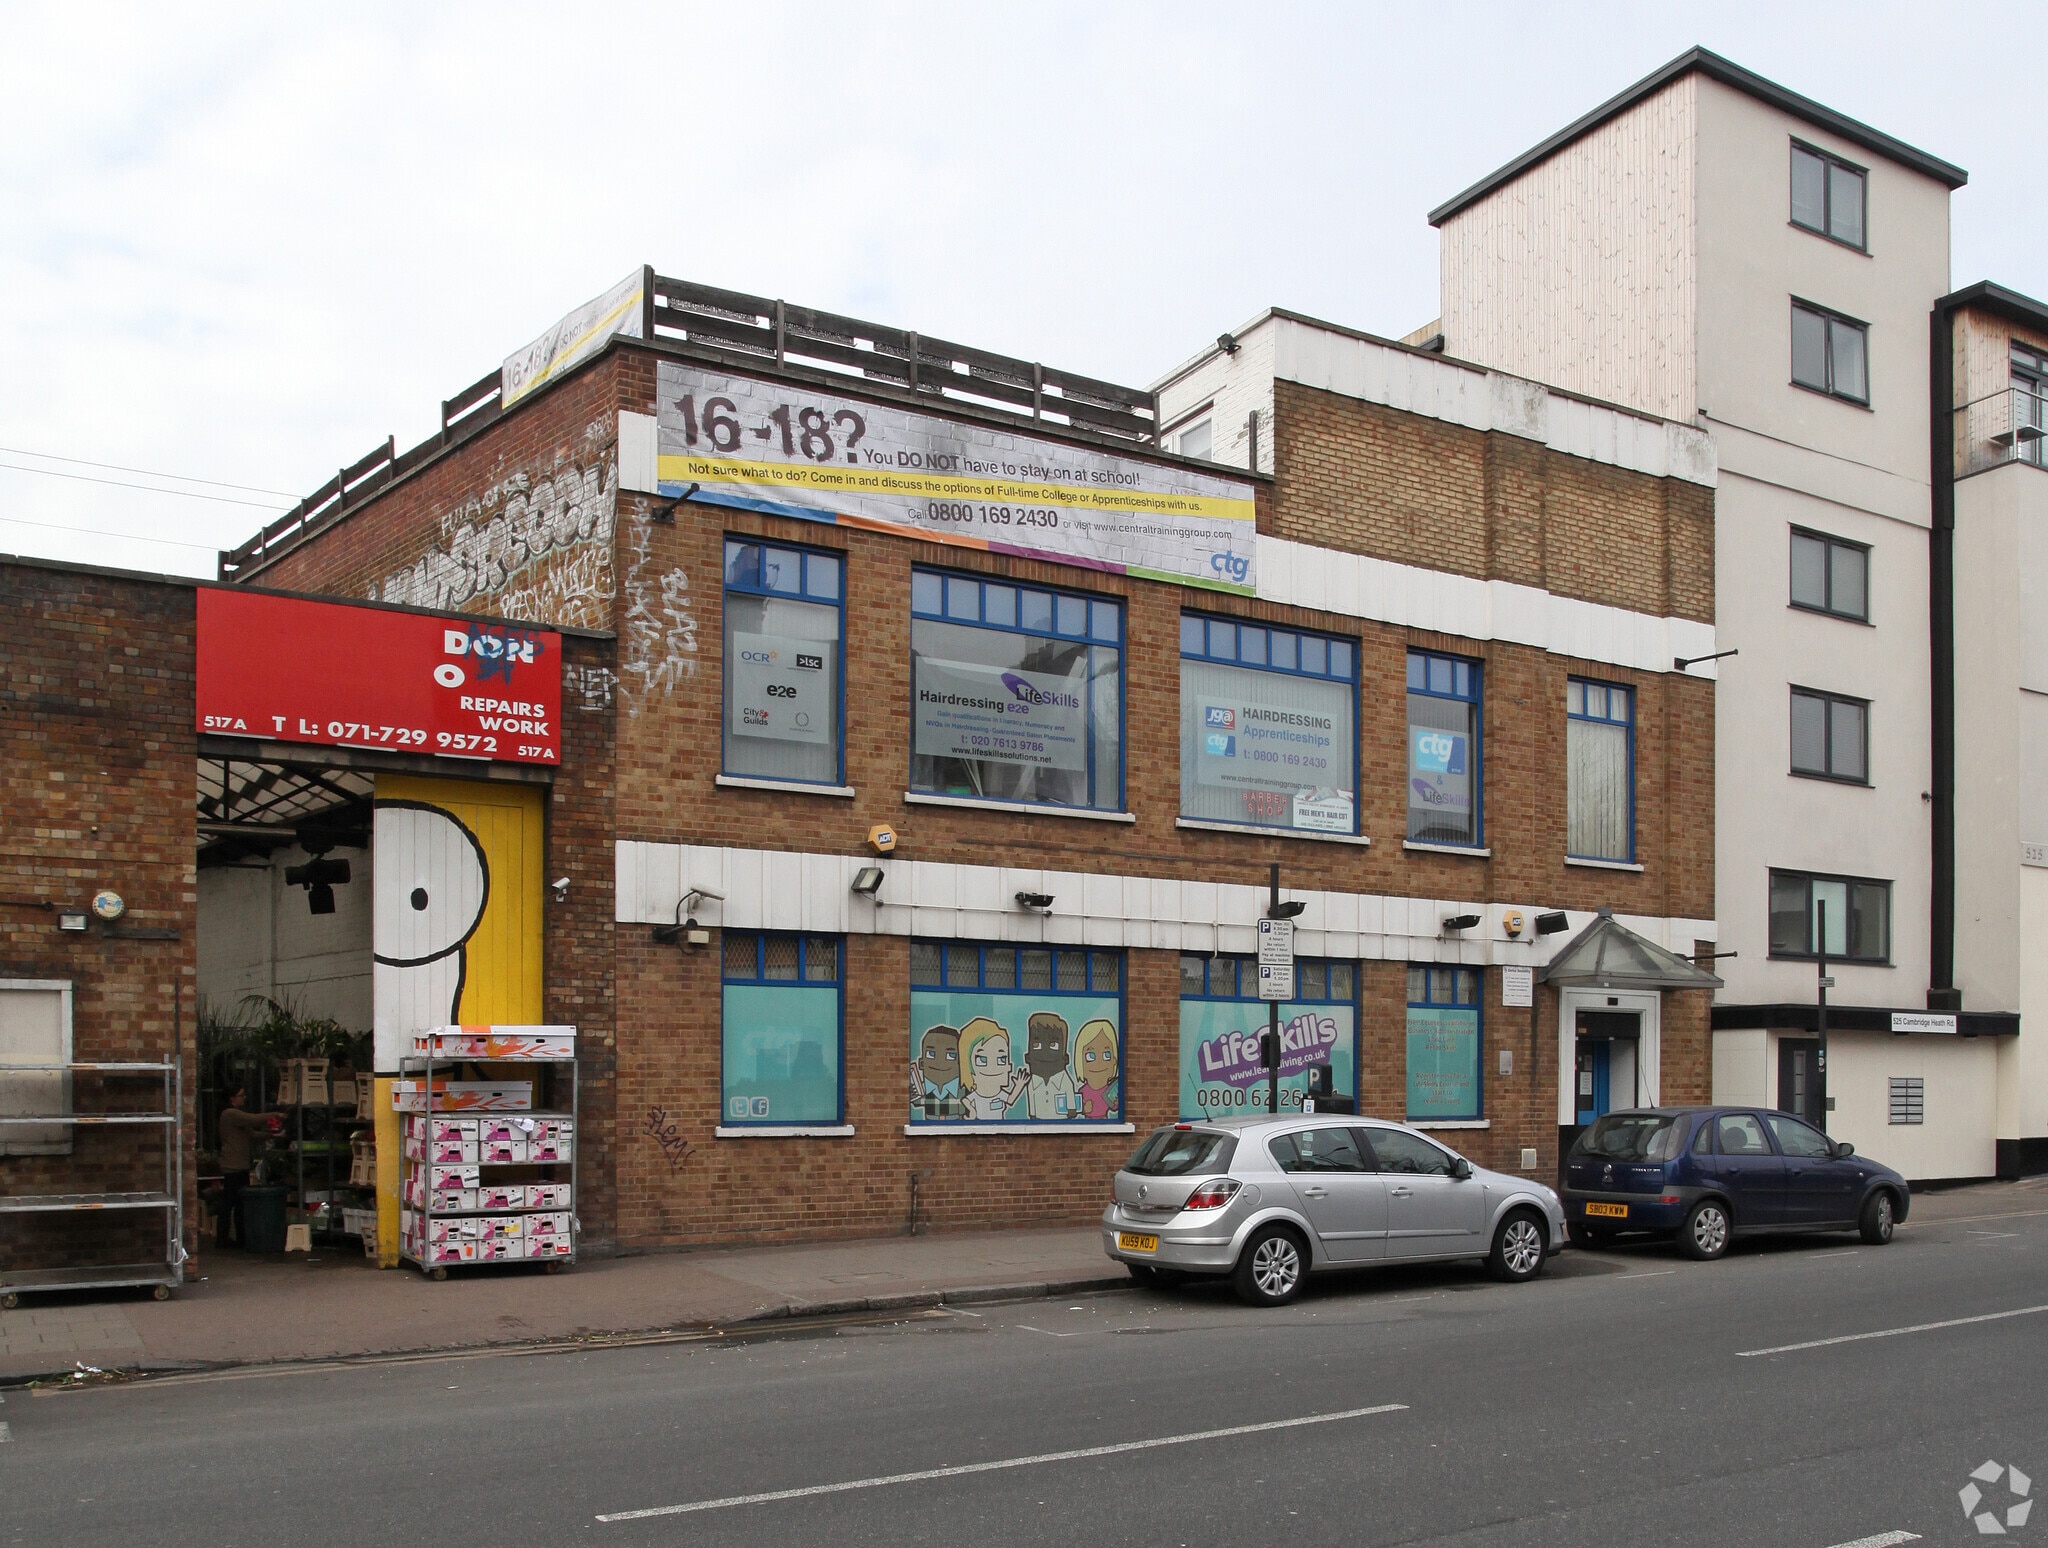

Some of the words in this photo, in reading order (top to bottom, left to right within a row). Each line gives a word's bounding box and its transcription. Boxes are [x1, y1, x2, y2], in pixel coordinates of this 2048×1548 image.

[864, 449, 893, 466] You
[898, 451, 922, 468] DO
[926, 452, 959, 470] NOT
[963, 457, 998, 474] have
[1001, 461, 1016, 475] to
[1020, 464, 1050, 481] stay
[1053, 469, 1071, 480] on
[1075, 468, 1087, 482] at
[1091, 470, 1140, 486] school!
[688, 462, 710, 475] Not
[712, 465, 738, 477] sure
[741, 467, 769, 479] what
[771, 469, 783, 480] to
[786, 468, 807, 482] do?
[810, 471, 843, 485] Come
[846, 473, 856, 485] in
[858, 476, 879, 487] and
[881, 478, 922, 490] discuss
[925, 480, 941, 491] the
[943, 483, 982, 495] options
[984, 484, 995, 495] of
[997, 485, 1039, 498] Full-time
[1042, 489, 1078, 503] College
[1092, 493, 1166, 510] Apprenticeships
[1167, 500, 1187, 510] with
[1189, 503, 1203, 511] us.
[908, 508, 927, 520] Call
[928, 502, 973, 522] 0800
[979, 505, 1011, 525] 169
[1015, 508, 1058, 528] 2430
[1063, 521, 1072, 529] or
[1074, 521, 1092, 531] visit
[1093, 522, 1233, 539] www.centraltraininggroup.com
[1210, 549, 1250, 582] ctg
[741, 651, 770, 663] OCR
[433, 664, 466, 688] O
[767, 684, 797, 698] e2e
[1016, 686, 1079, 709] LifeSkills
[460, 695, 546, 718] REPAIRS
[920, 690, 1004, 713] Hairdressing
[1007, 702, 1029, 714] e2e
[478, 715, 550, 736] WORK
[743, 716, 769, 726] Guilds
[936, 710, 951, 718] Gain
[952, 711, 991, 723] qualifications
[1025, 721, 1053, 732] Numeracy
[1242, 707, 1332, 730] HAIRDRESSING
[204, 715, 248, 731] 517A
[327, 721, 428, 746] 071-729
[436, 731, 498, 752] 9572
[517, 745, 555, 759] 517A
[926, 719, 943, 728] NVQs
[951, 722, 990, 734] Hairdressing
[992, 727, 1025, 737] Guaranteed
[1026, 731, 1042, 739] Salon
[1043, 733, 1076, 743] Placements
[1243, 725, 1330, 748] Apprenticeships
[961, 734, 968, 745] t:
[971, 735, 990, 747] 020
[993, 738, 1018, 749] 7613
[1019, 741, 1044, 752] 9786
[1207, 733, 1228, 750] ctg
[1419, 733, 1454, 762] ctg
[951, 746, 1052, 763] www.lifeskillssolutions.net
[1243, 749, 1251, 759] t:
[1253, 750, 1279, 763] 0800
[1282, 753, 1300, 765] 169
[1302, 756, 1327, 769] 2430
[1220, 774, 1317, 791] www.centraltraininggroup.com
[1436, 775, 1443, 785] &
[1241, 792, 1288, 805] BARBER
[1423, 789, 1471, 807] LifeSkills
[1247, 803, 1284, 816] SHOP
[1298, 809, 1310, 817] FREE
[1263, 923, 1270, 932] P
[1263, 967, 1270, 977] P
[1893, 1017, 1902, 1025] 525
[1903, 1018, 1930, 1028] Cambridge
[1931, 1019, 1945, 1027] Heath
[1309, 1068, 1320, 1087] P
[1197, 1089, 1244, 1107] 0800
[1121, 1234, 1139, 1248] KU59
